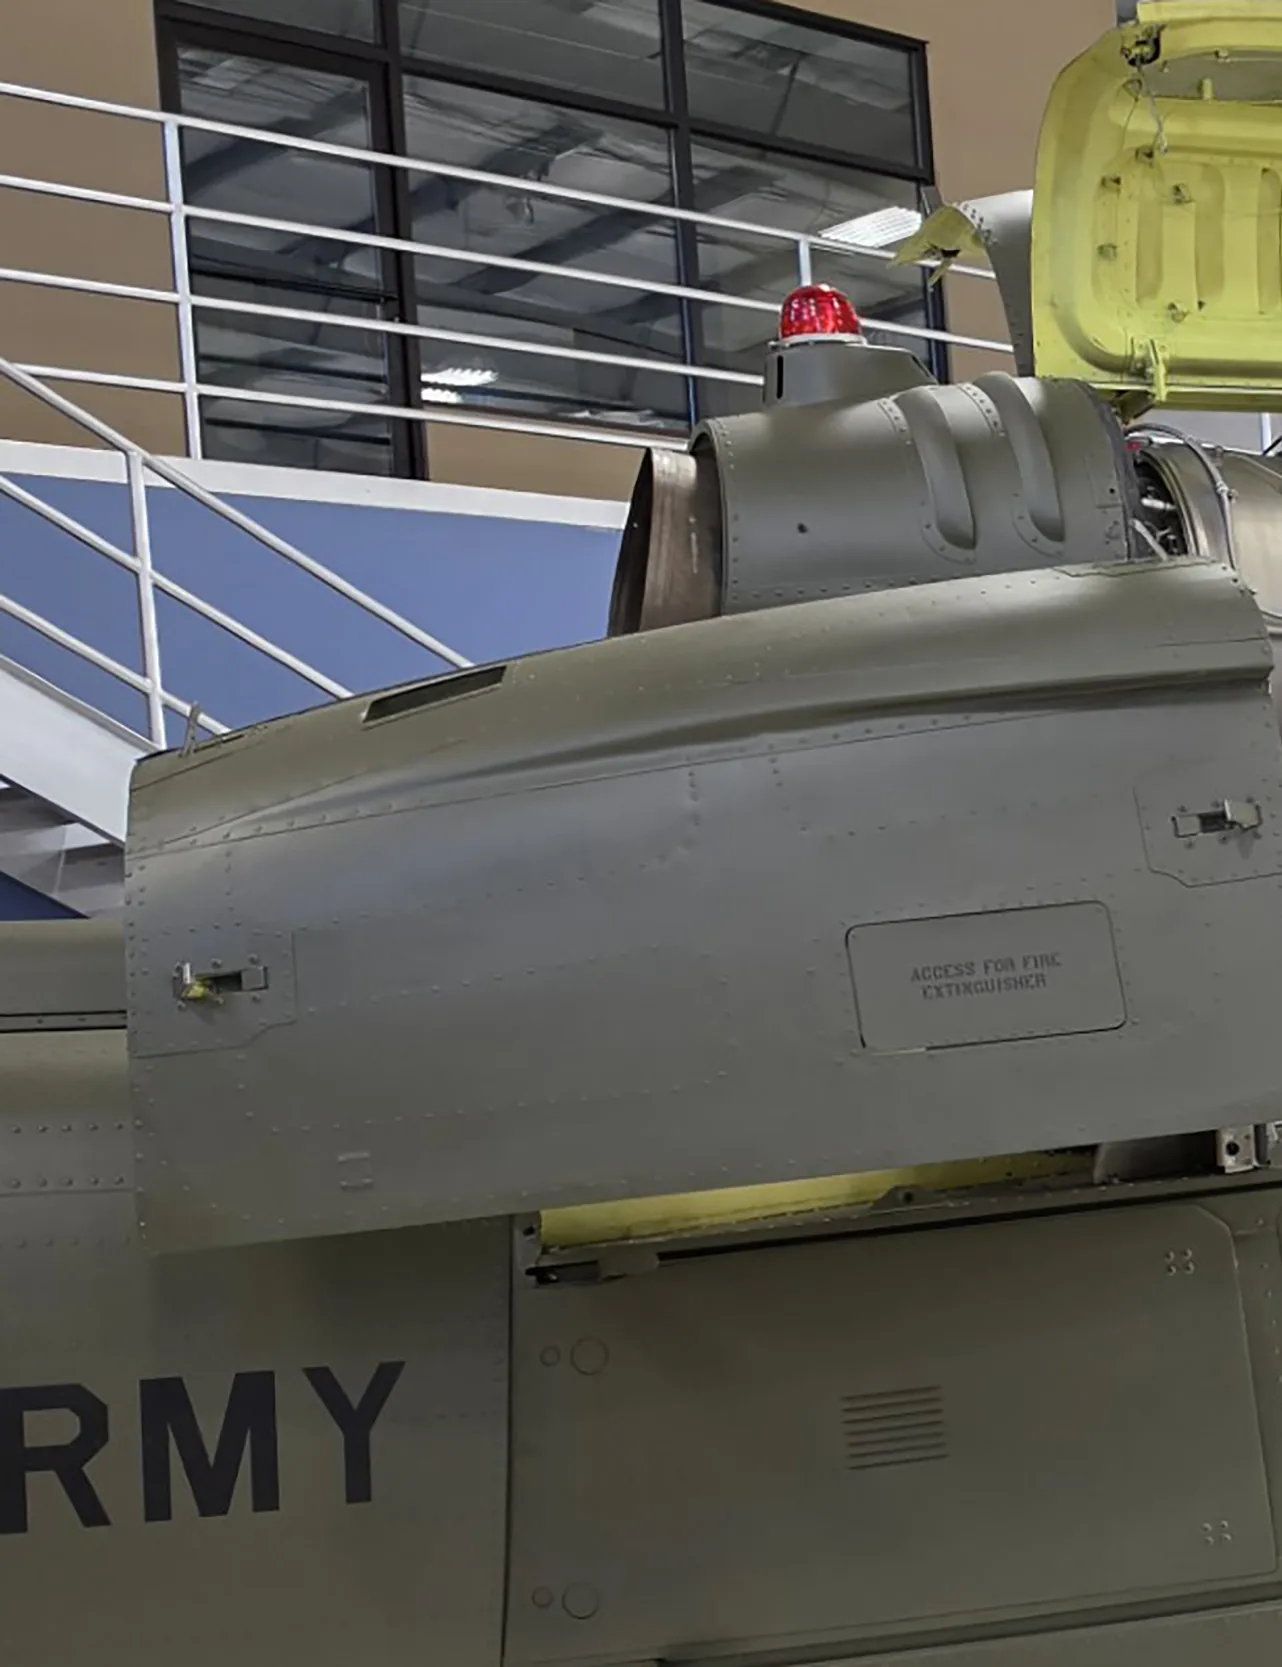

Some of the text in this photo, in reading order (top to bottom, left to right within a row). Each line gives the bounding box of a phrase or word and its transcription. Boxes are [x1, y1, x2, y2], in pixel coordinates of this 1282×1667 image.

[910, 952, 1063, 983] ACCESS FOR FIRE
[921, 973, 1048, 1001] EXTINGUISHER
[0, 1361, 406, 1535] RMY
